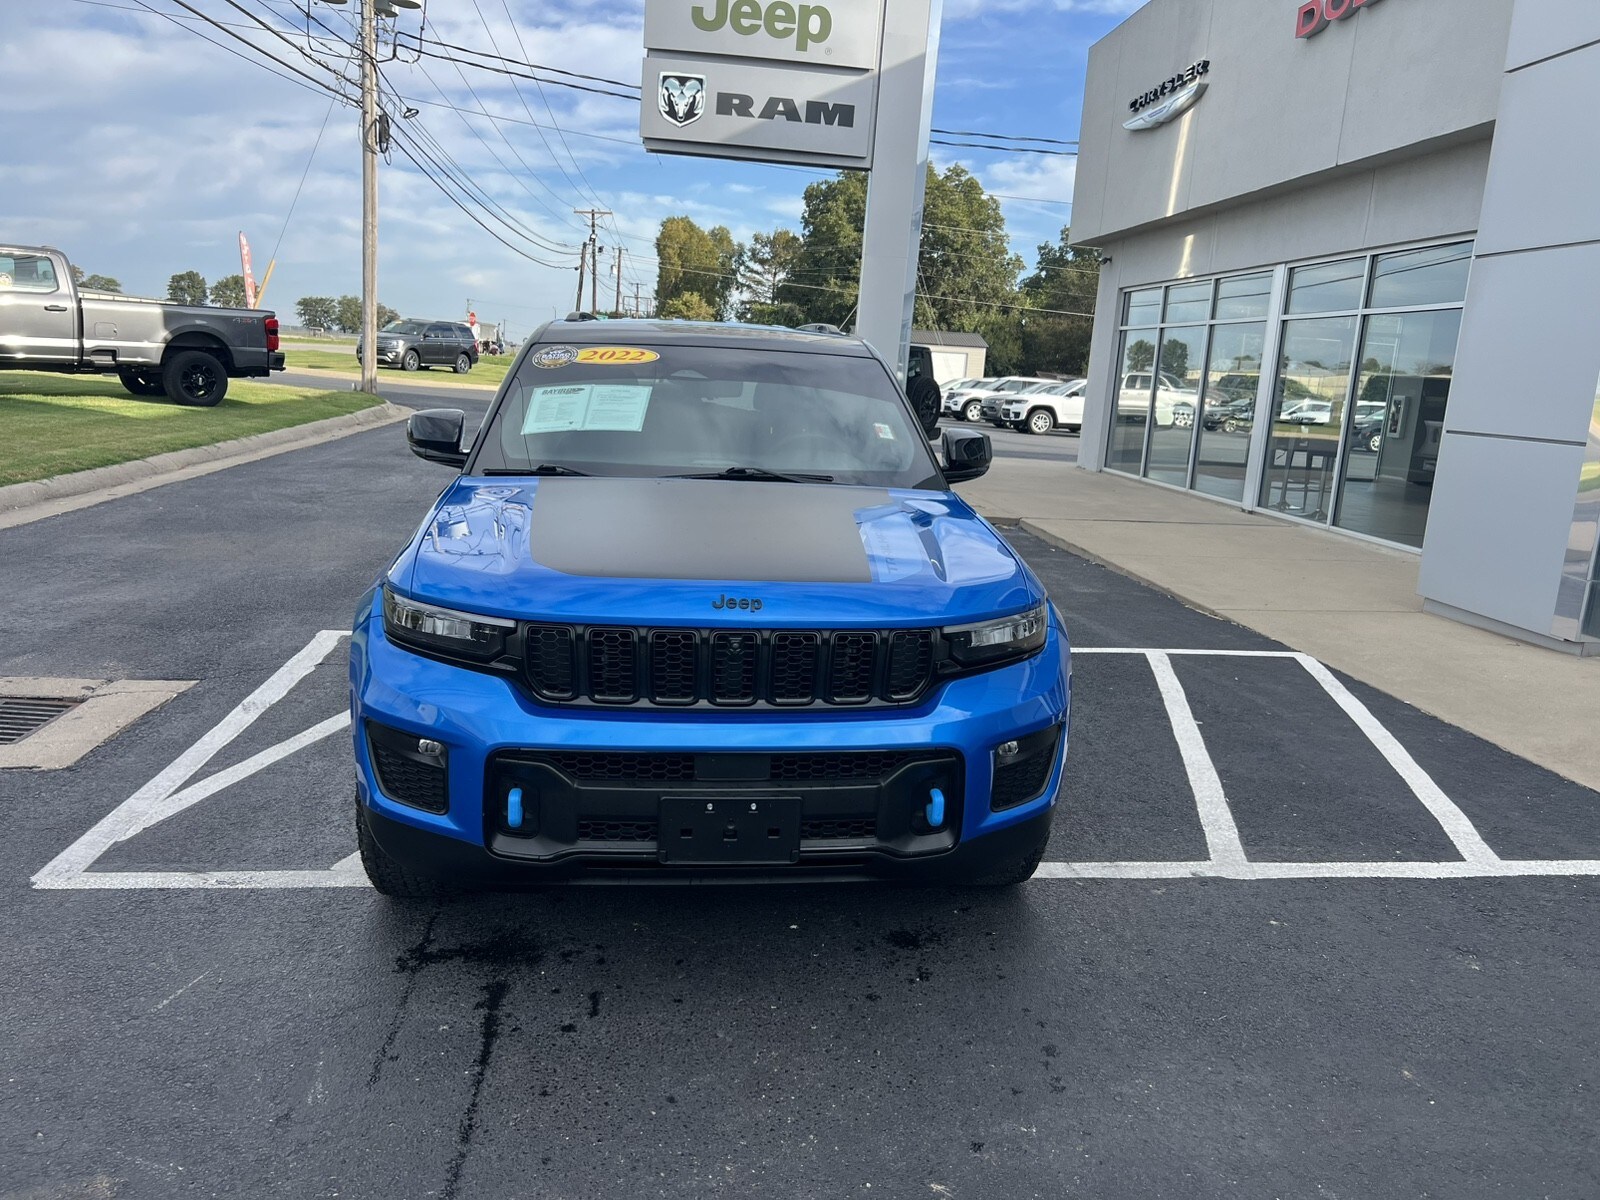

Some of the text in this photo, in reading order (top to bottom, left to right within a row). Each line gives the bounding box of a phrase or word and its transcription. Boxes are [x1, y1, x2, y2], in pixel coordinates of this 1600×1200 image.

[691, 0, 833, 52] Jeep
[1295, 0, 1374, 39] DO
[1129, 59, 1210, 113] CHRYSLER
[716, 92, 856, 128] RAM
[581, 350, 646, 361] 2022
[711, 594, 763, 613] Jeep
